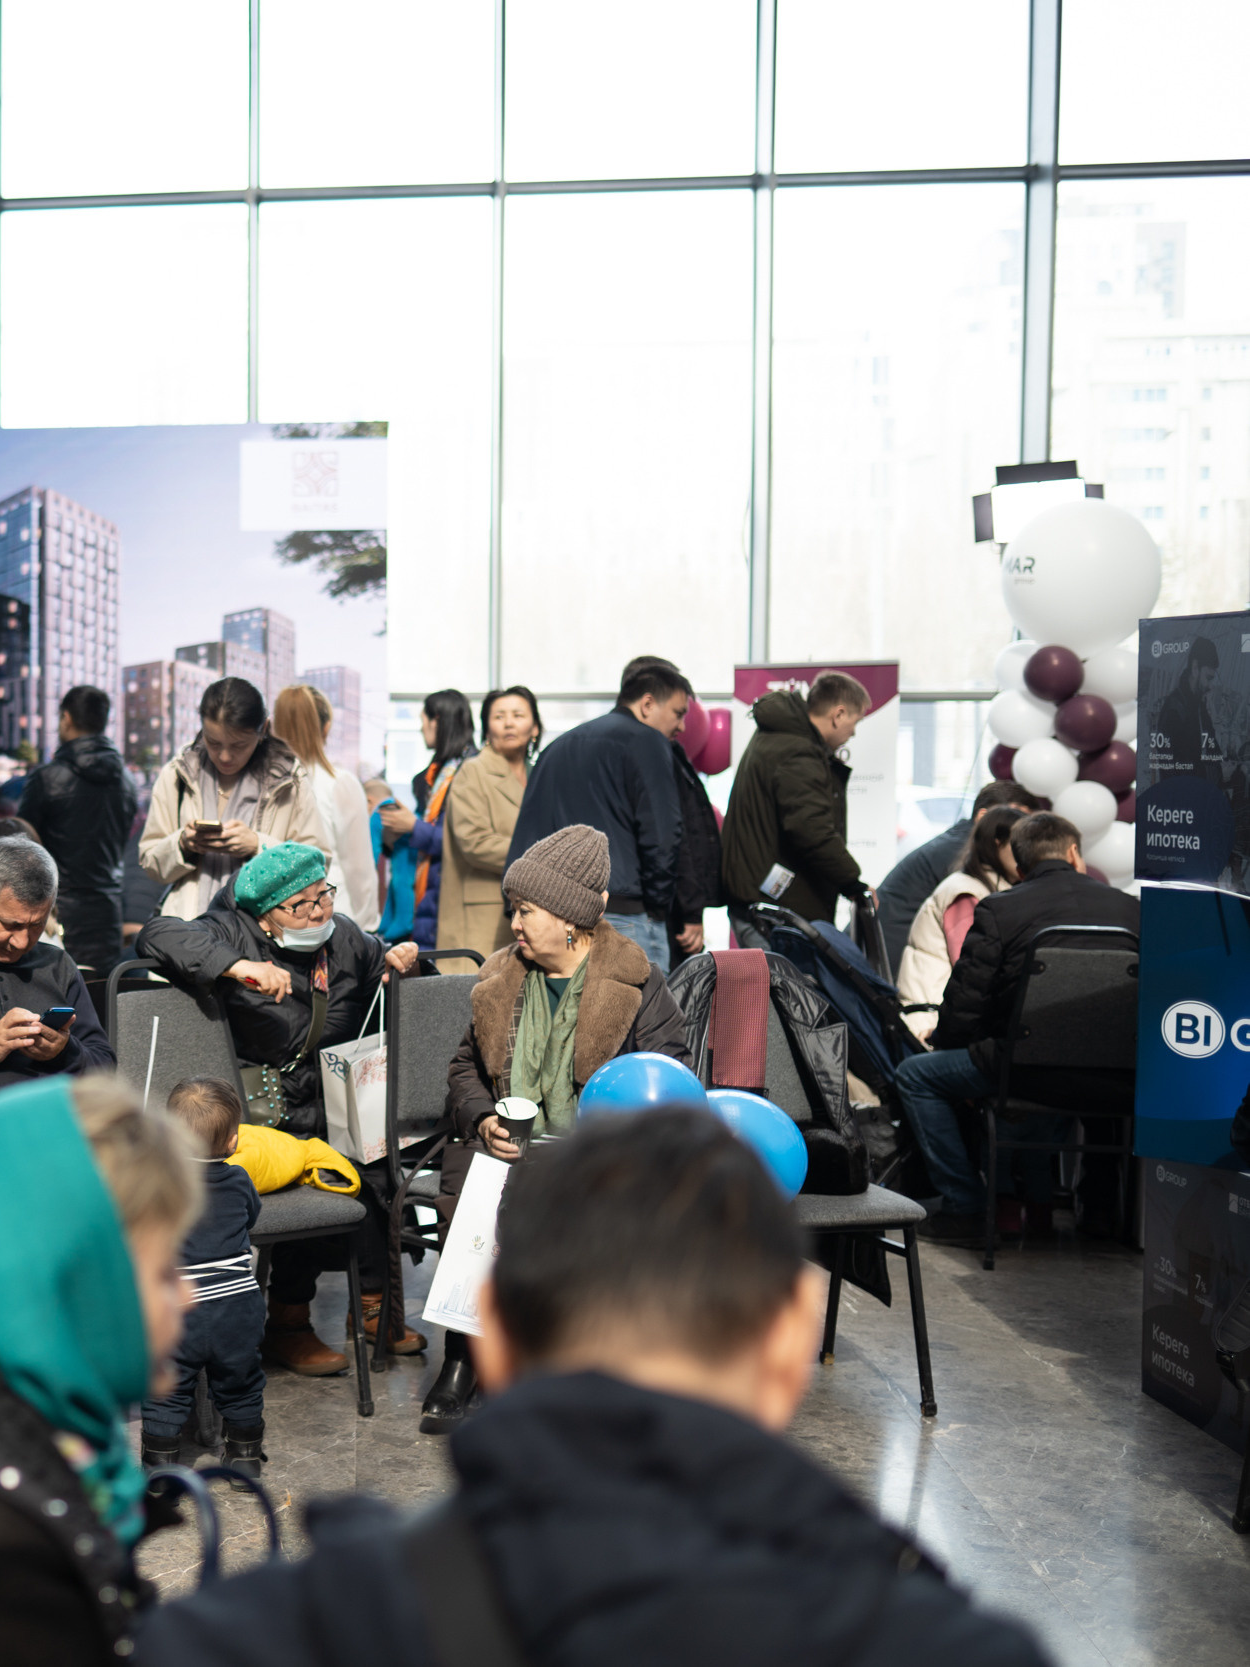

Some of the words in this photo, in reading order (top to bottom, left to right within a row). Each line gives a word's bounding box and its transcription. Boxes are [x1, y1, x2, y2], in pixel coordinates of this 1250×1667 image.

[1163, 642, 1189, 654] GROUP
[1150, 733, 1171, 748] 30%
[1201, 733, 1215, 748] 7%
[1147, 804, 1193, 826] Кереге
[1146, 832, 1200, 850] ипотека
[1175, 1013, 1212, 1047] BI
[1165, 1171, 1187, 1187] GROUP
[1152, 1323, 1190, 1359] Кереге
[1152, 1351, 1195, 1387] ипотека
